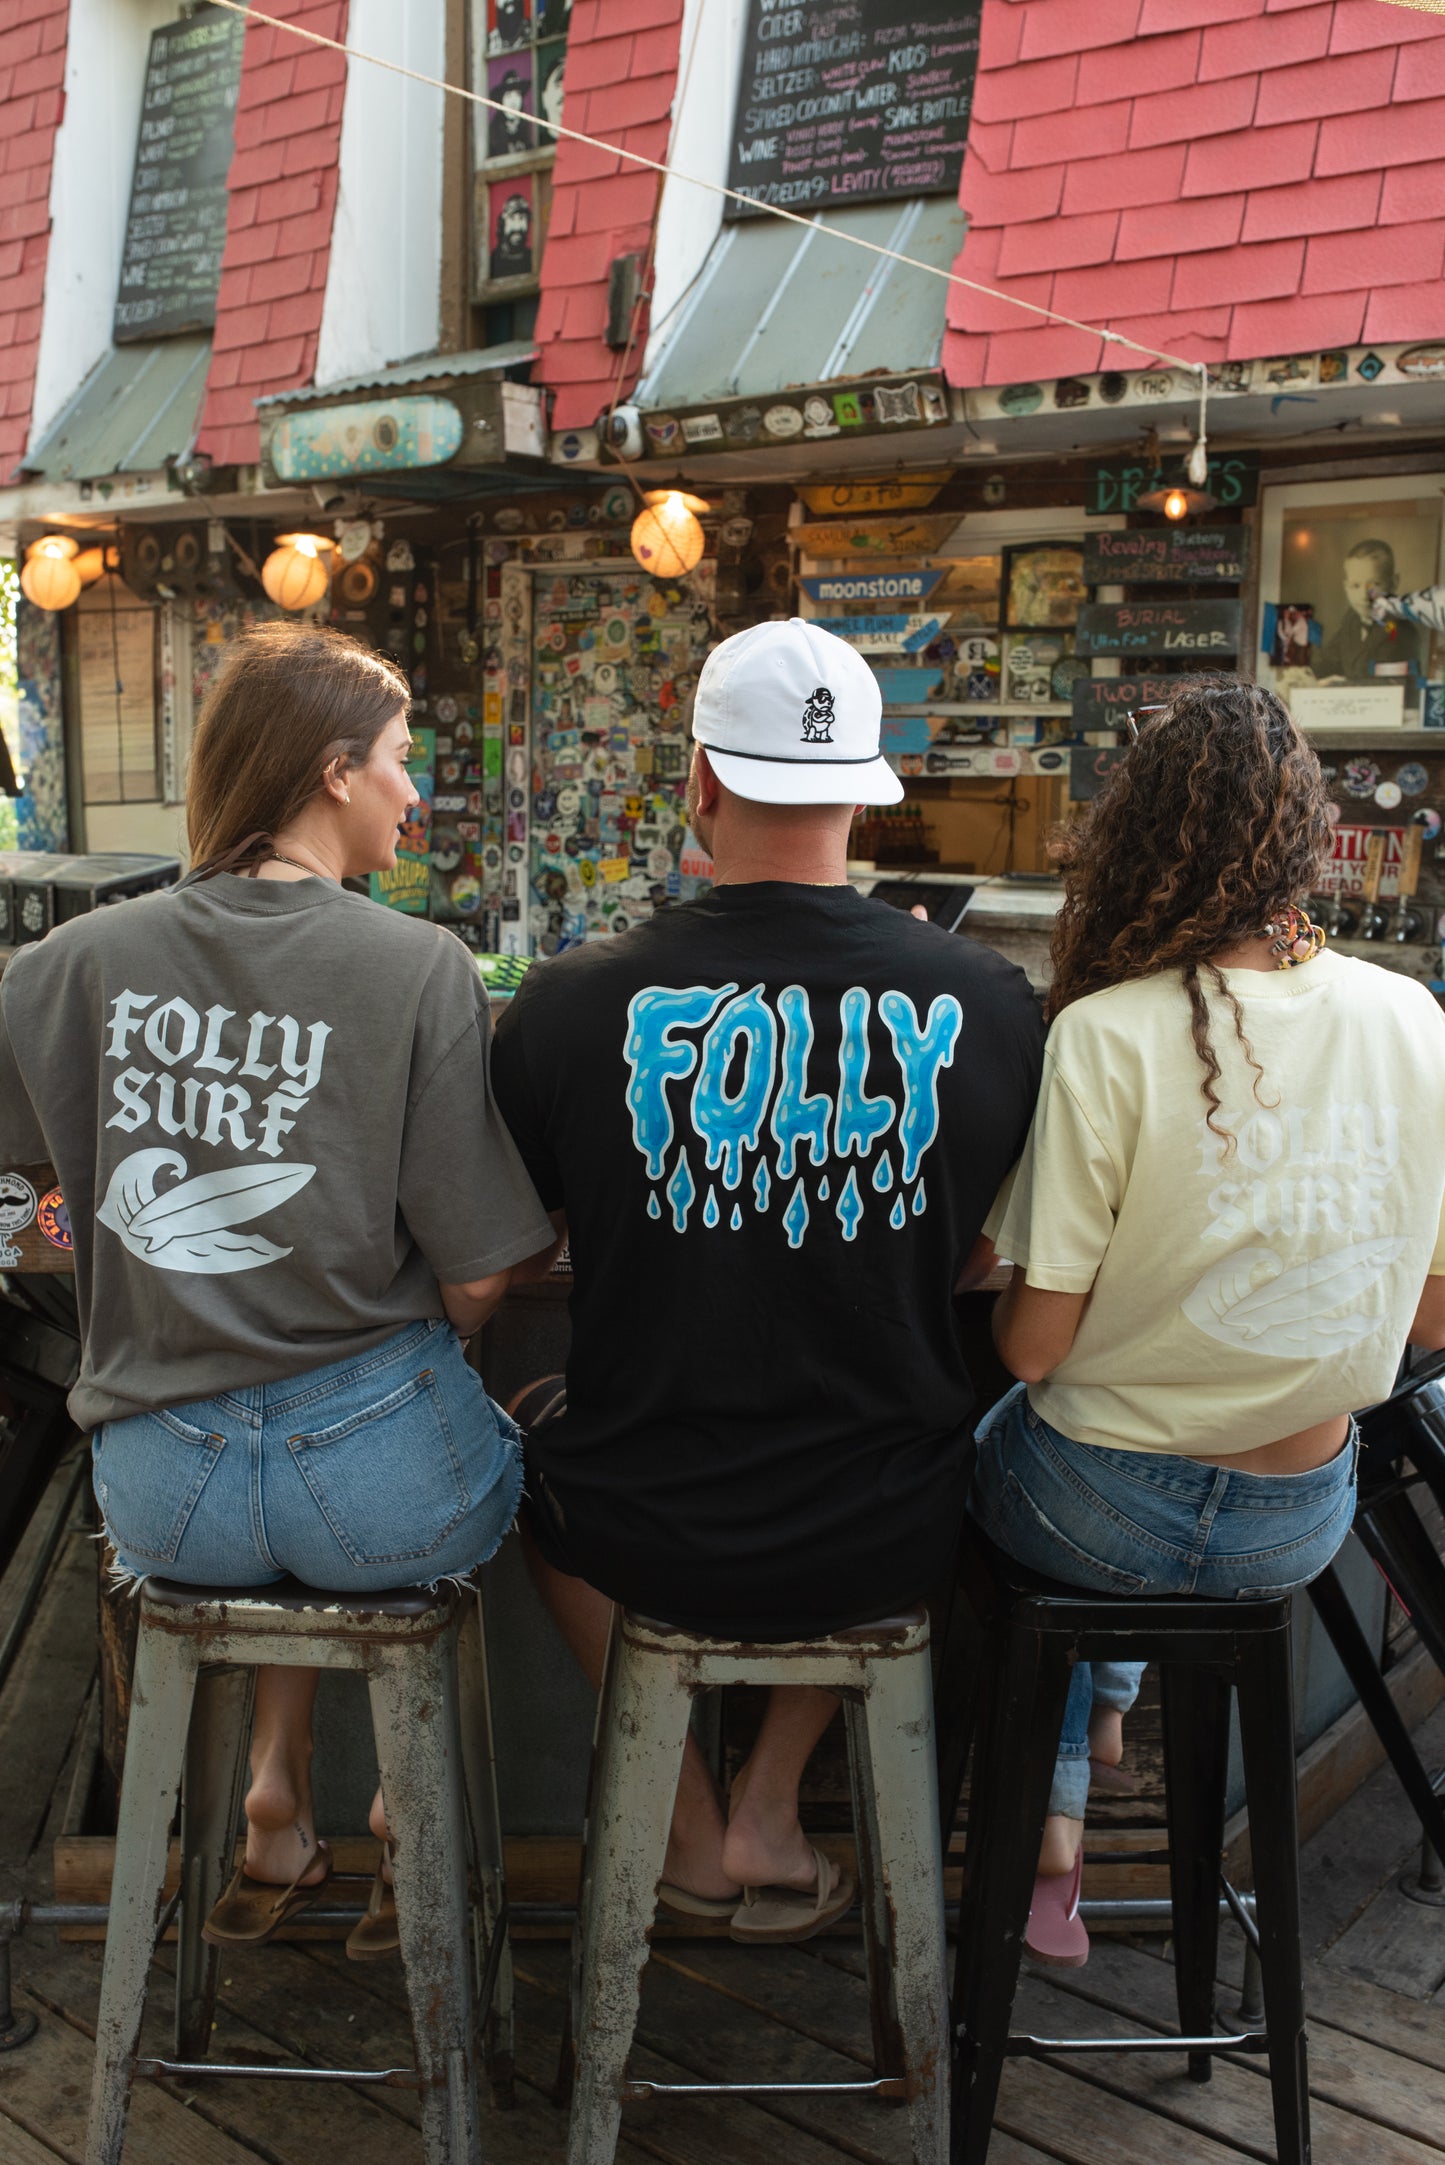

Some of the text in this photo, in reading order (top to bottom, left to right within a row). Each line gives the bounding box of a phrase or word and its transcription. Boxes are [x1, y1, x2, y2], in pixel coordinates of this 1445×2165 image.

[831, 167, 882, 194] LEVITY
[1141, 377, 1168, 396] THC
[819, 576, 924, 599] moonstone
[1115, 608, 1188, 628] BURIAL
[1163, 629, 1232, 651] LAGER
[1091, 682, 1138, 704] TWO
[105, 988, 333, 1097] FOLLY
[623, 983, 963, 1191] FOLLY
[105, 1066, 309, 1158] SURF
[1195, 1102, 1400, 1178] FOLLY
[1199, 1172, 1394, 1241] SURF
